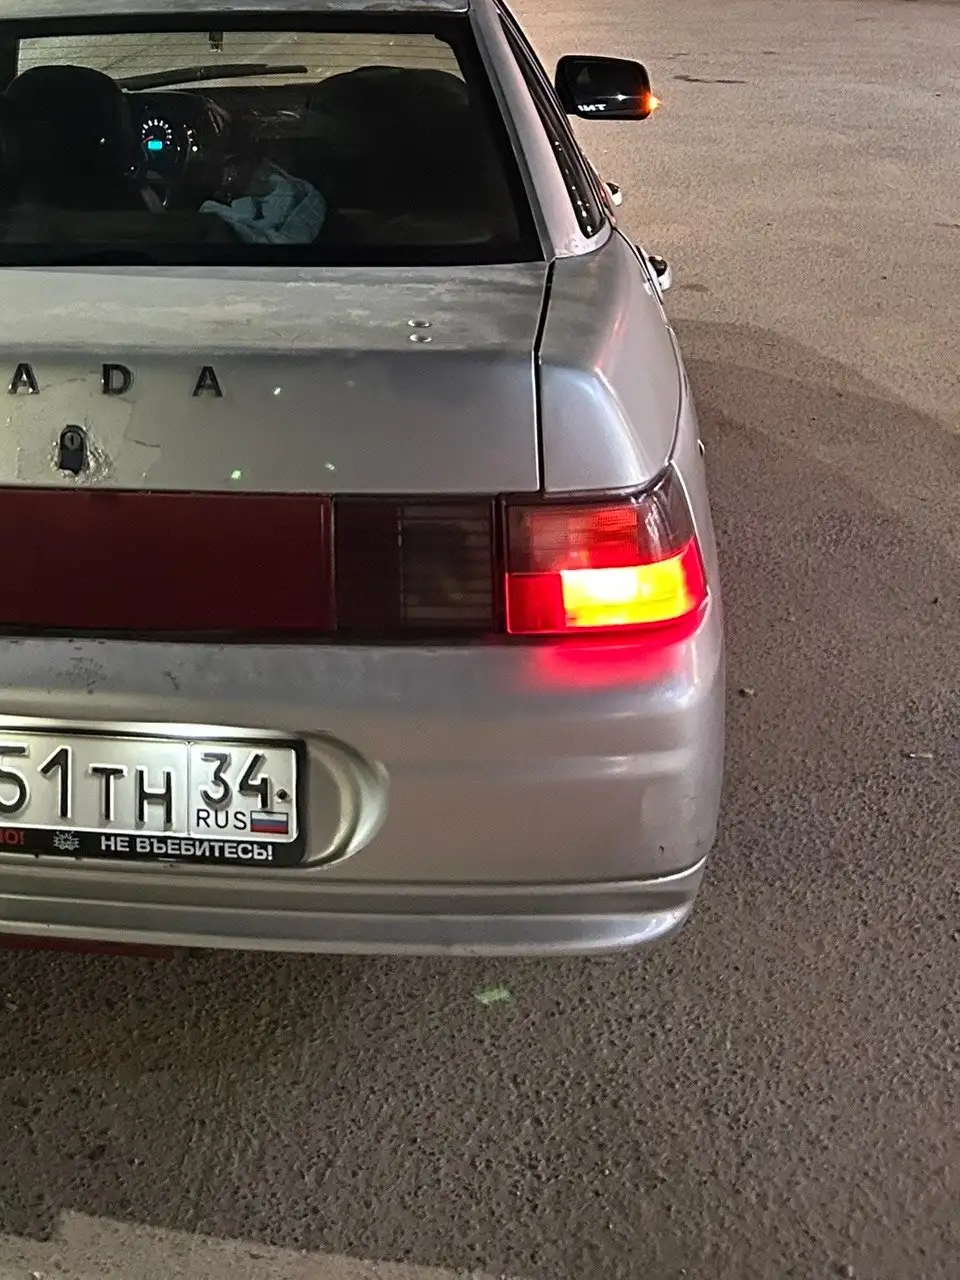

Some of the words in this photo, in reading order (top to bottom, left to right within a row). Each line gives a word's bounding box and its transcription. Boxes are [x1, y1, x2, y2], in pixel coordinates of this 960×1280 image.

[196, 808, 248, 830] RUS
[100, 835, 131, 852] НЕ
[136, 837, 273, 861] ВЪЕБИТЕСЬ!
